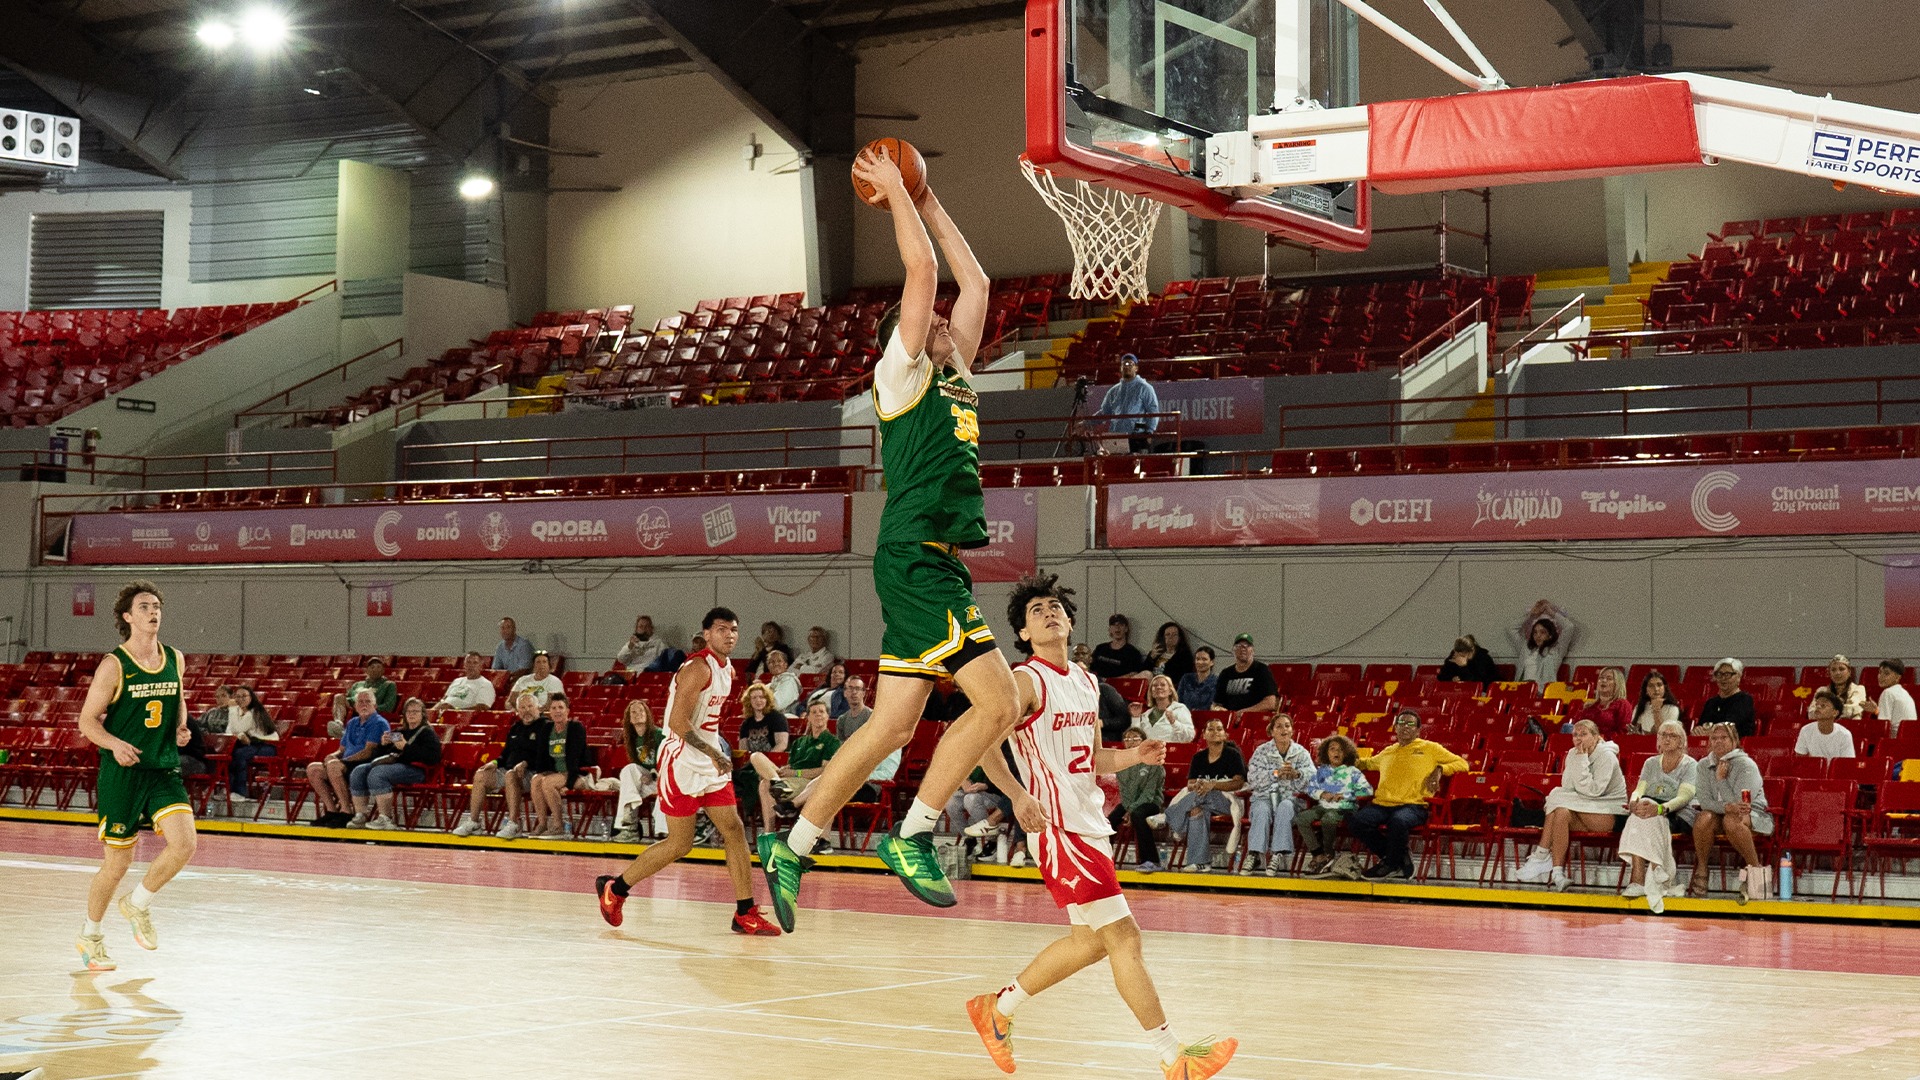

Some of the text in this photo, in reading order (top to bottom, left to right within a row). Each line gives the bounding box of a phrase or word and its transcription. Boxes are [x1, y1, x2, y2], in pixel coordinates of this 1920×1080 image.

[1283, 141, 1312, 149] WARNING
[1806, 159, 1848, 173] GARED
[1192, 396, 1235, 420] OESTE
[1771, 484, 1840, 501] Chobani
[1121, 495, 1164, 513] Pan
[1374, 498, 1432, 523] CEFI
[1491, 496, 1562, 527] CARIDAD
[1587, 494, 1666, 520] Tropiko
[1772, 500, 1840, 513] 20g Protein
[704, 508, 733, 530] Slim
[767, 505, 822, 524] Viktor
[306, 528, 358, 540] POPULAR
[531, 519, 608, 542] QDOBA
[774, 524, 817, 543] Pollo
[962, 549, 1005, 558] Warranties
[128, 682, 179, 692] NORTHERN
[131, 688, 178, 698] MICHIGAN
[144, 700, 163, 728] 3
[1068, 745, 1096, 774] 2
